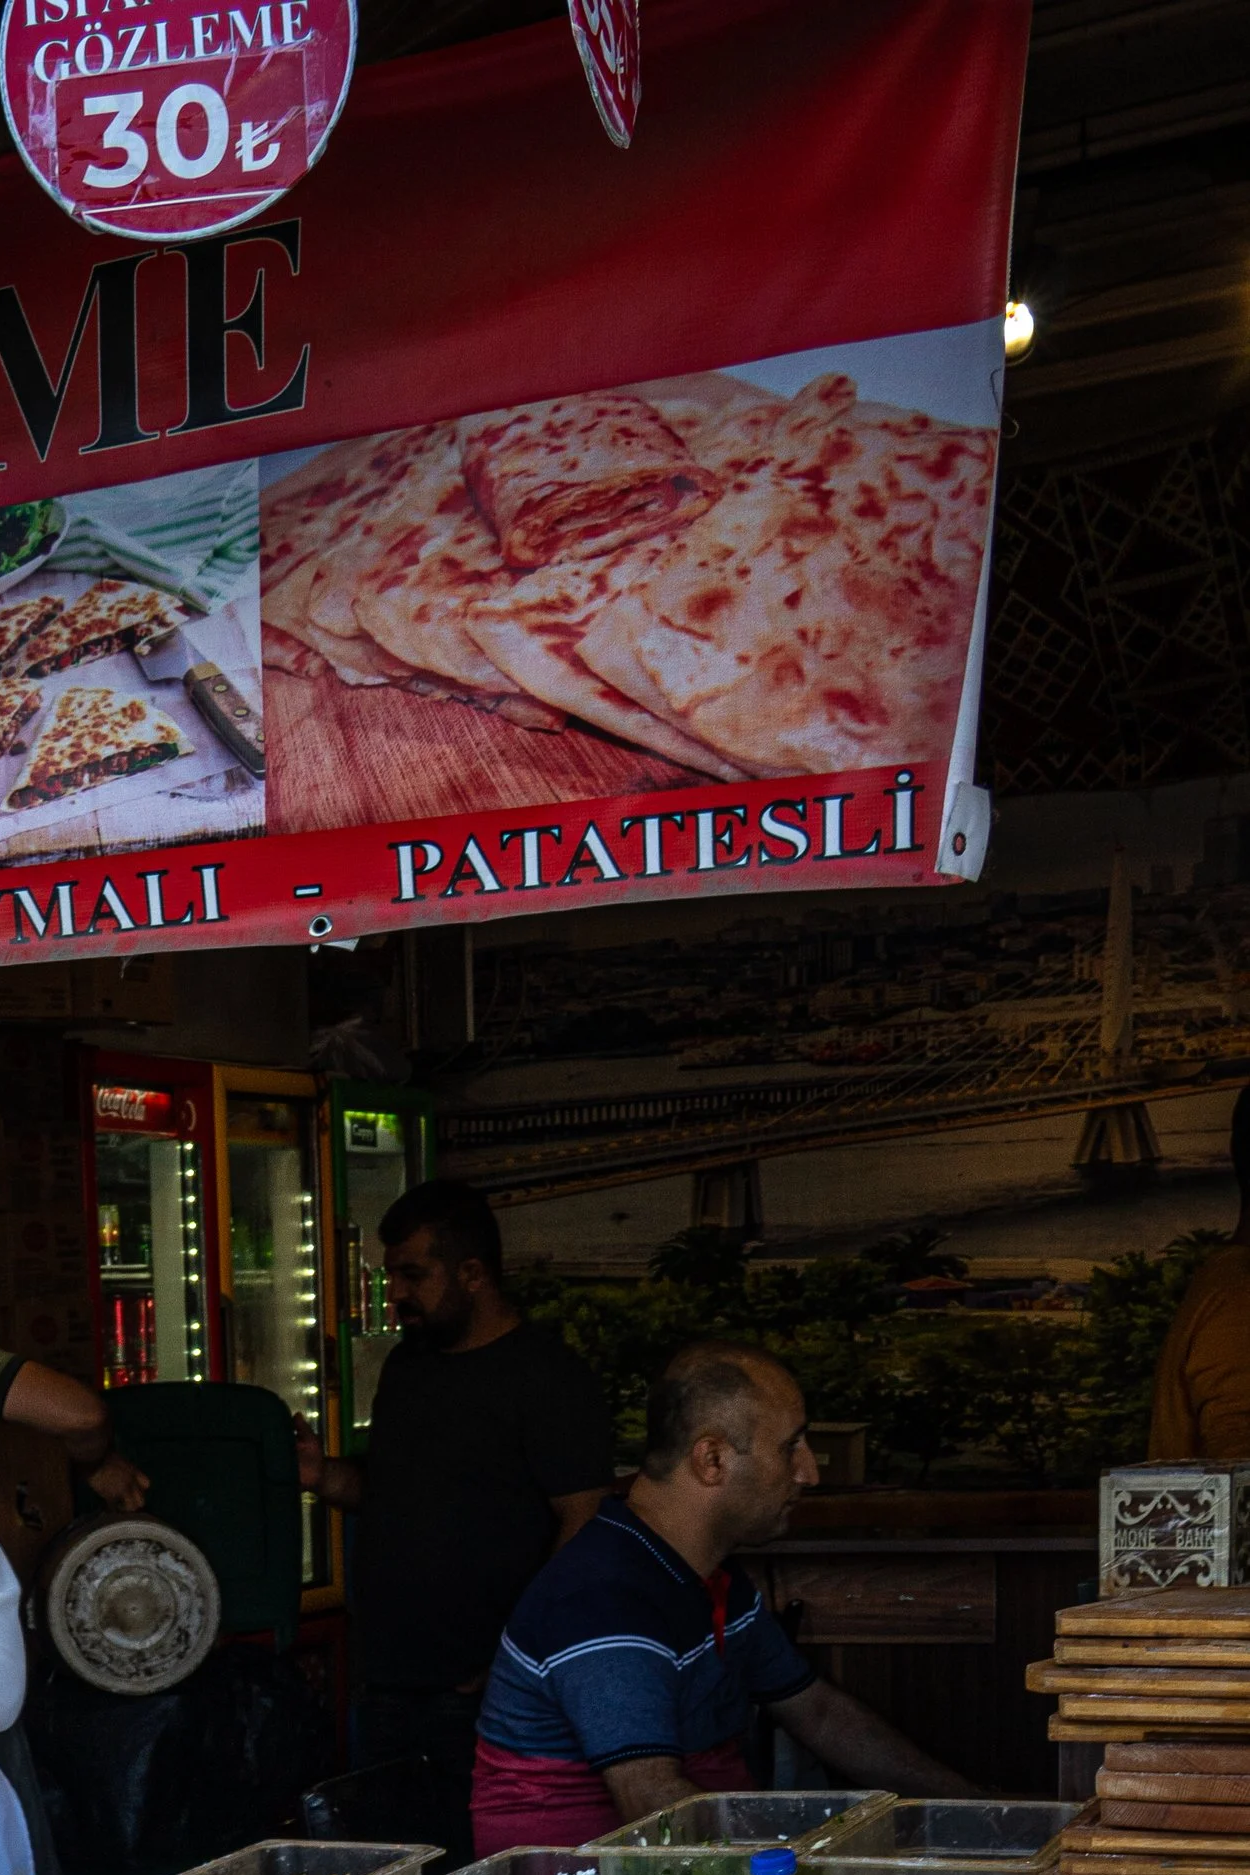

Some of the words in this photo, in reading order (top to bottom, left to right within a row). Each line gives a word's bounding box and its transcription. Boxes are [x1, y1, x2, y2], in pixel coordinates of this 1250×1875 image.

[34, 0, 312, 83] GÖZLEME
[81, 82, 281, 189] 30₺
[389, 769, 925, 903] PATATESLİ
